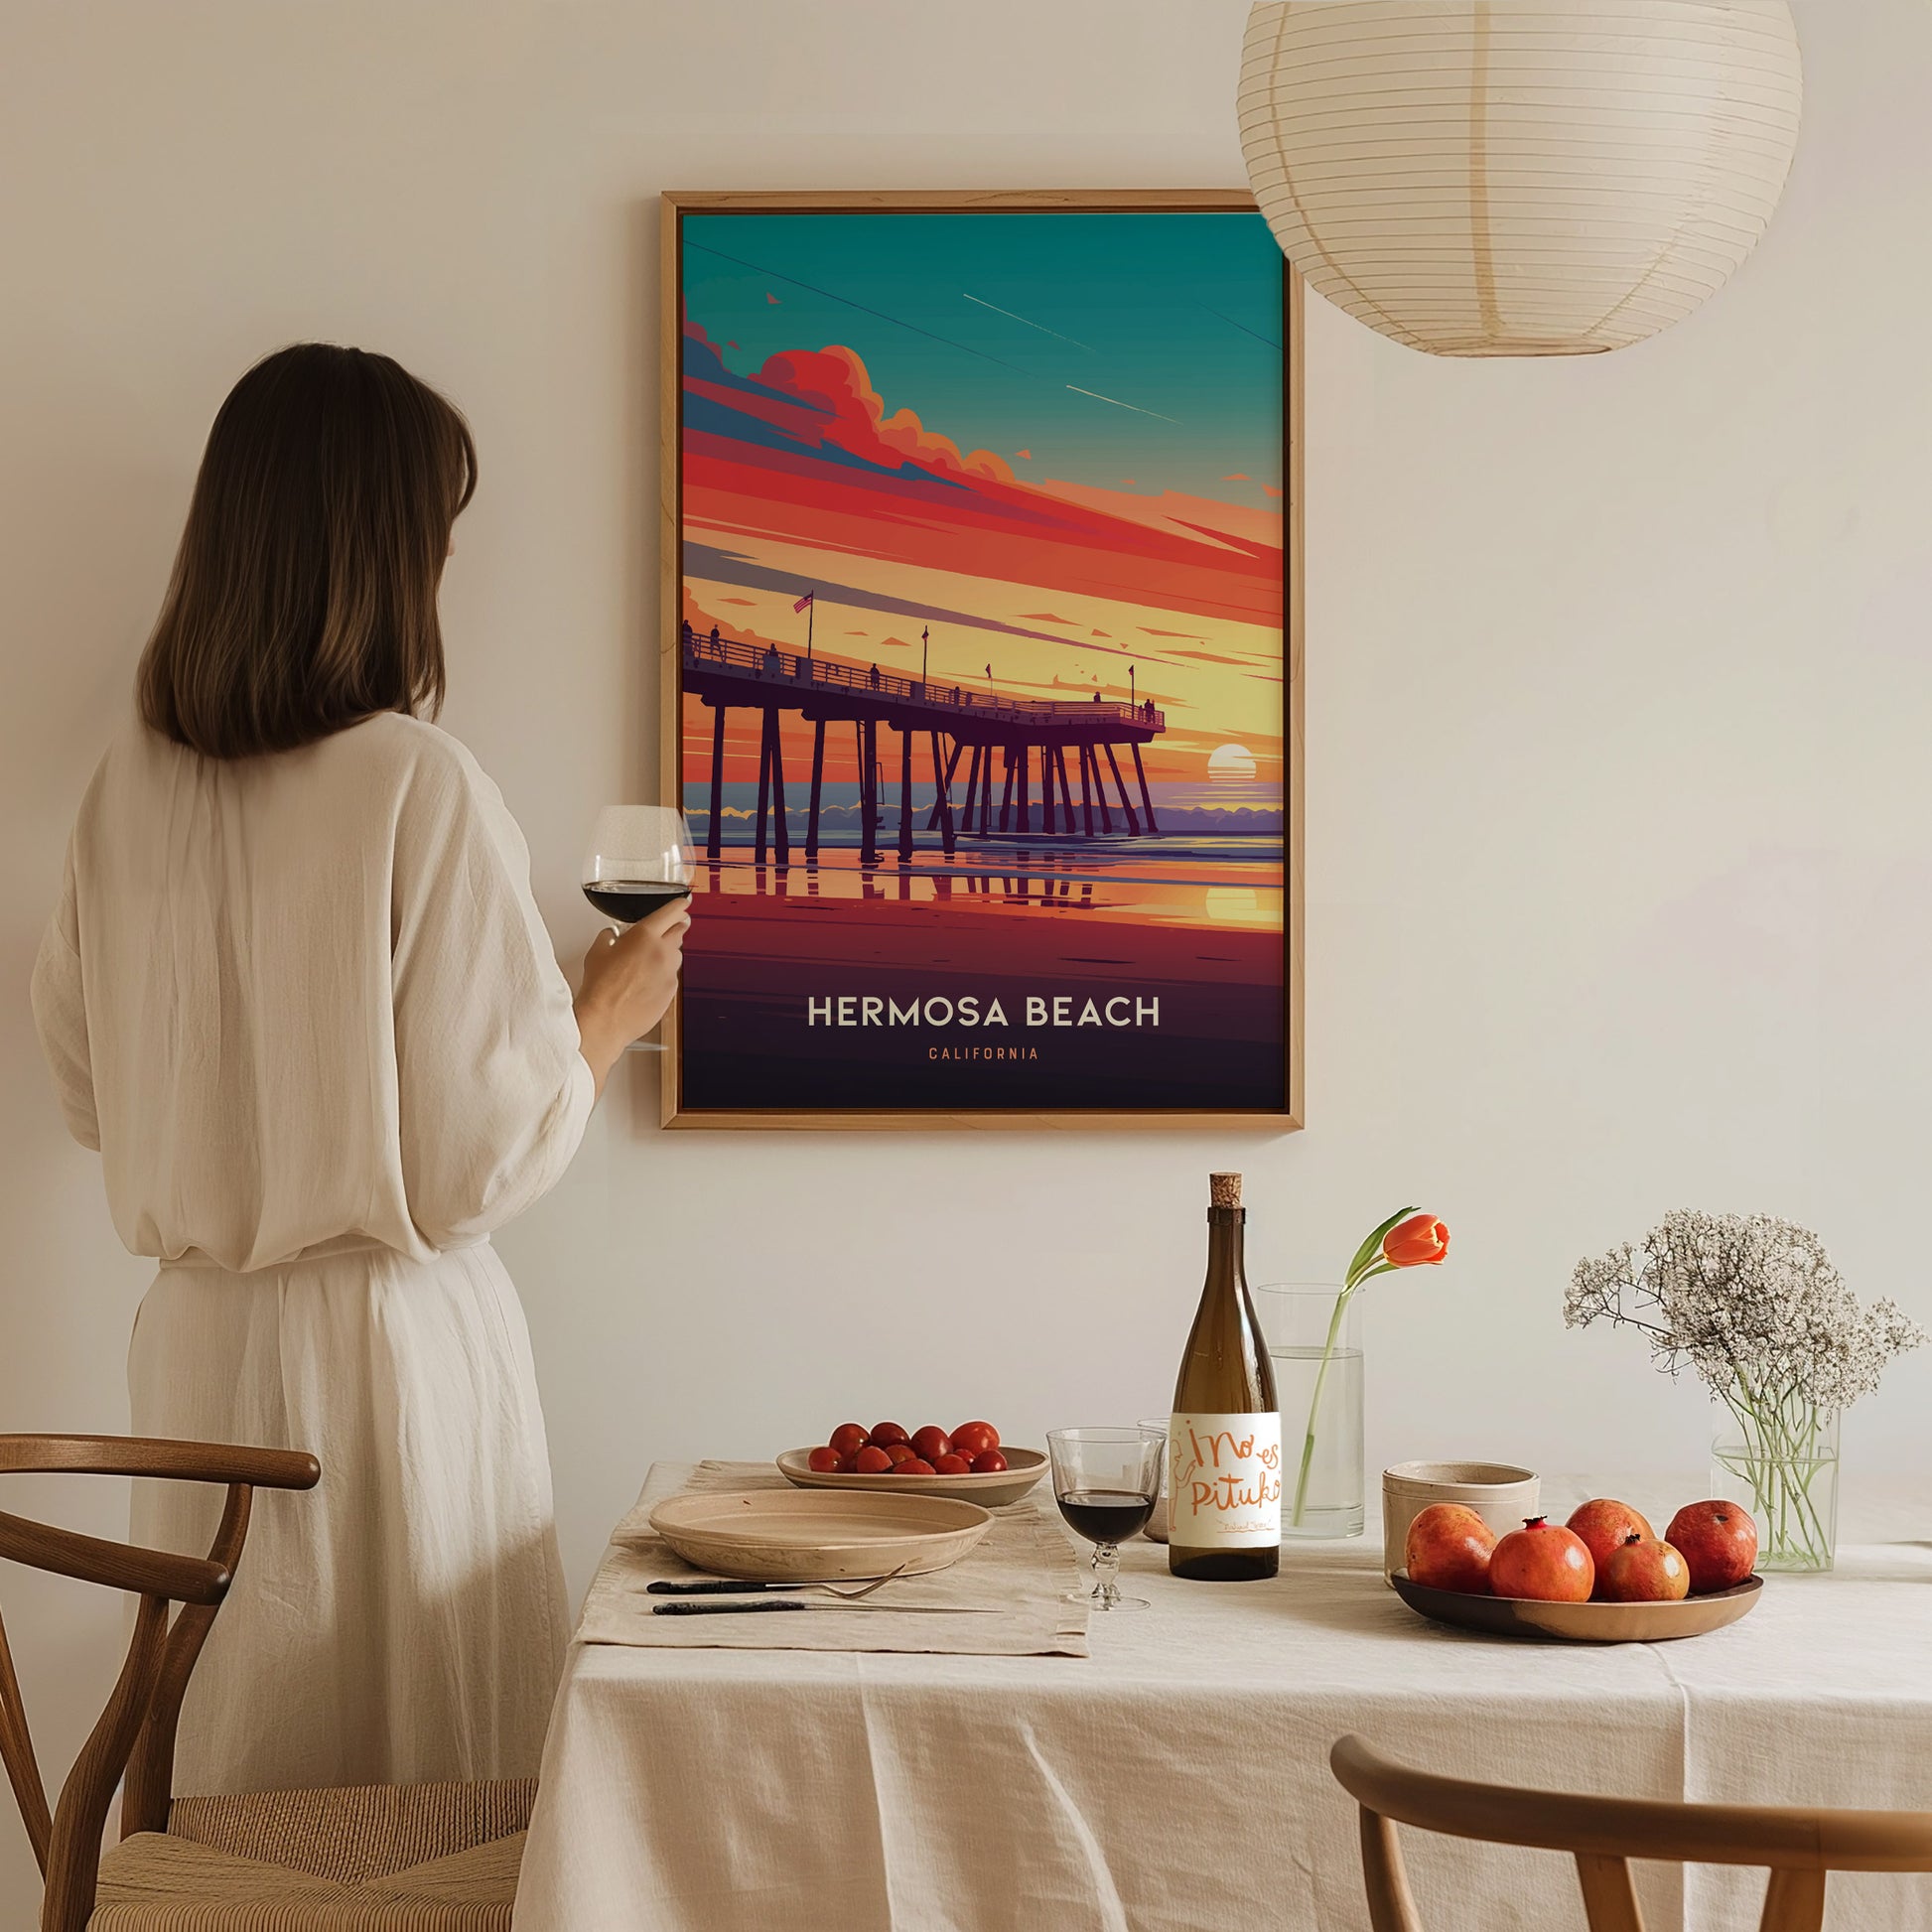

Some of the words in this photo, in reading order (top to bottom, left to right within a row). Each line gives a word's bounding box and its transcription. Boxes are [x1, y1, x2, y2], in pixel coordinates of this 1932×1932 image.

[808, 997, 1009, 1027] HERMOSA
[1026, 997, 1160, 1027] BEACH
[928, 1047, 1037, 1060] CALIFORNIA
